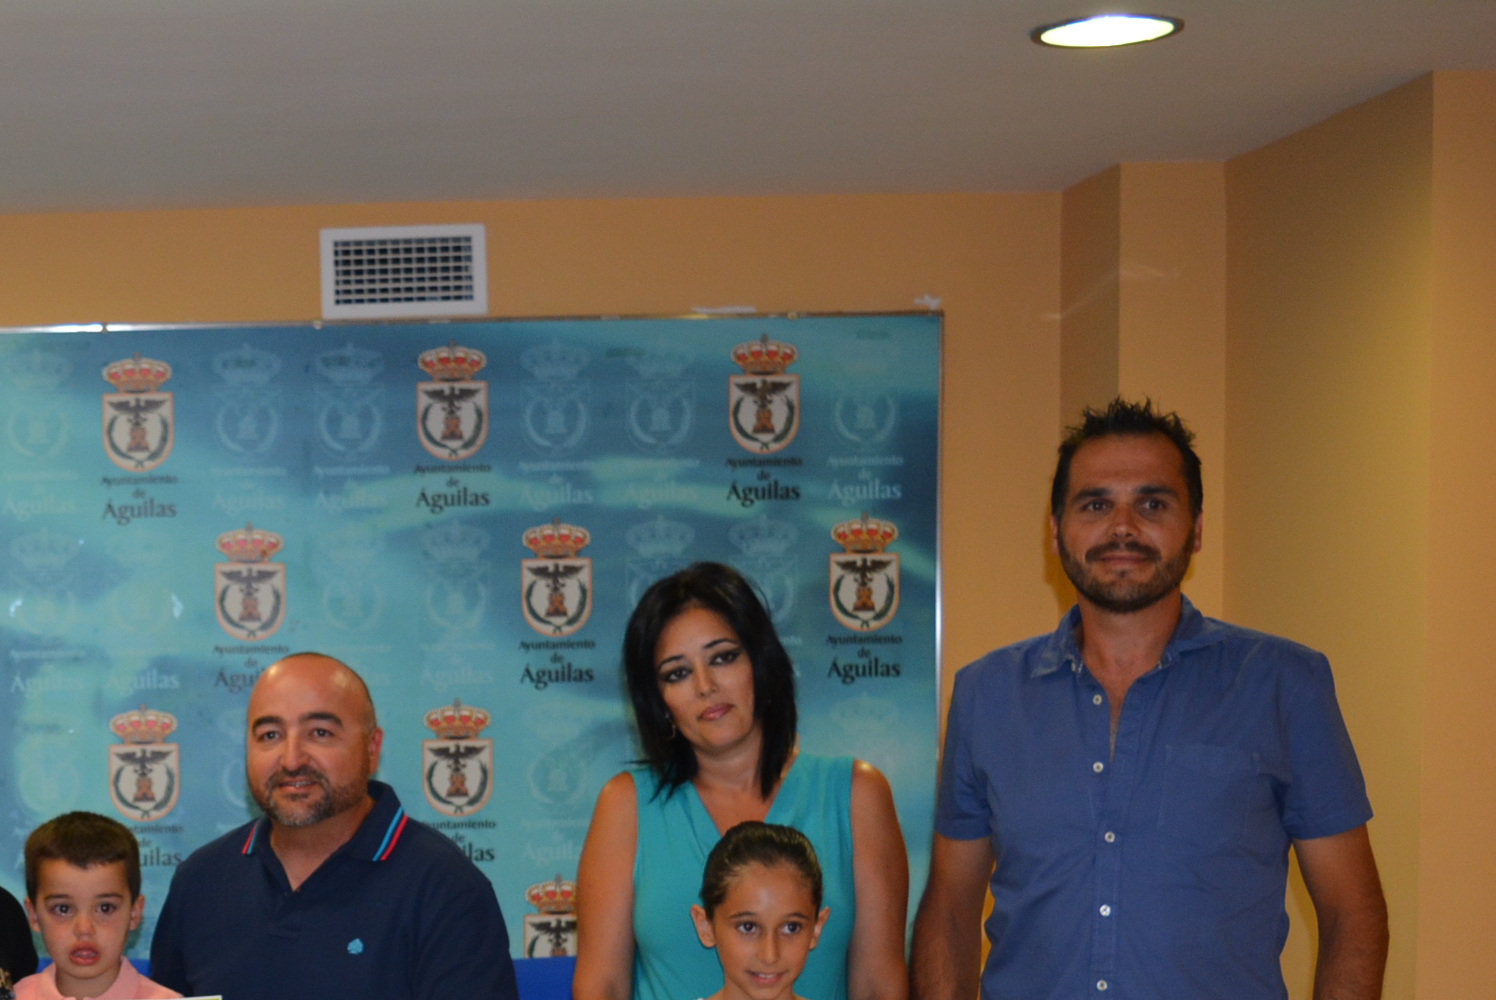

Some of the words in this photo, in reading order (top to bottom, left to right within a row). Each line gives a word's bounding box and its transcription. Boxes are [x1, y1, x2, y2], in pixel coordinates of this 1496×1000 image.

[726, 457, 802, 471] Ayuntamiento
[827, 455, 903, 469] Ayuntamiento
[415, 463, 491, 477] Ayuntamiento
[757, 469, 771, 481] de
[102, 473, 178, 487] Ayuntamiento
[446, 475, 460, 487] de
[133, 485, 147, 497] de
[520, 485, 595, 511] Águilas
[727, 481, 802, 507] Águilas
[828, 479, 903, 505] Águilas
[416, 488, 491, 514] Águilas
[103, 498, 178, 524] Águilas
[519, 639, 595, 653] Ayuntamiento
[826, 635, 902, 649] Ayuntamiento
[214, 645, 289, 659] Ayuntamiento
[550, 651, 564, 663] de
[857, 647, 871, 659] de
[245, 657, 258, 668] de
[520, 663, 595, 689] Águilas
[827, 658, 902, 684] Águilas
